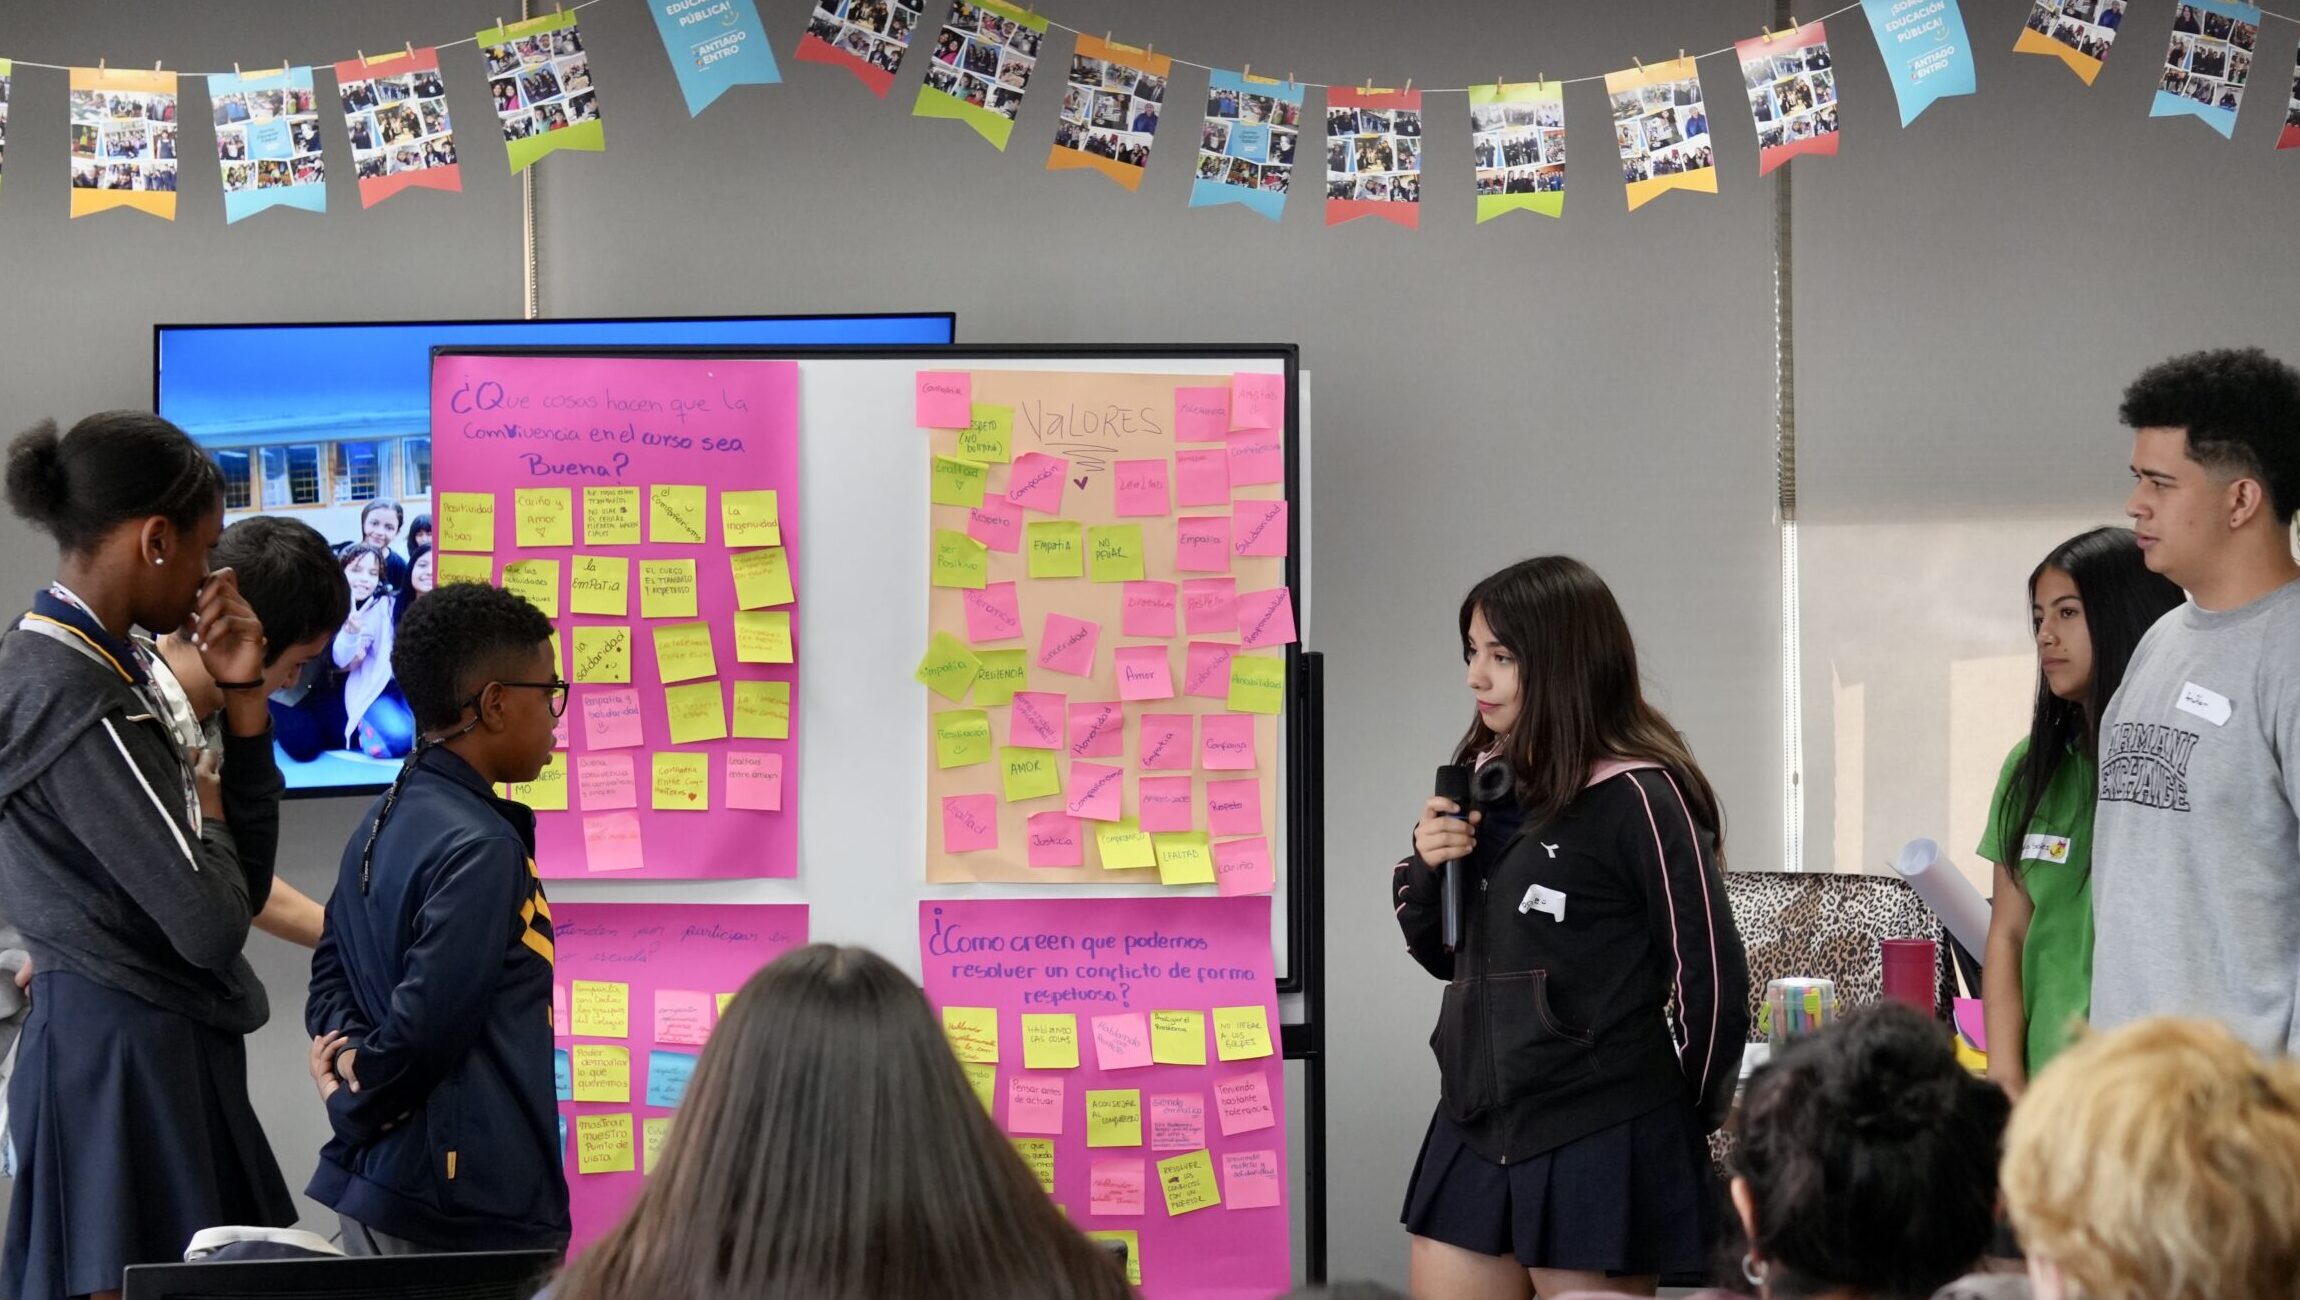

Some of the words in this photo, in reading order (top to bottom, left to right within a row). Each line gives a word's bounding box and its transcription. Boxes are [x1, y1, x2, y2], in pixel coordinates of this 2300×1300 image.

[679, 1, 732, 27] PÚBLICA!
[1885, 2, 1946, 32] EDUCACIÓN
[542, 391, 599, 409] cosas
[606, 390, 664, 410] hacen
[641, 431, 693, 450] curso
[702, 433, 746, 452] sea
[520, 451, 631, 485] Buena?
[1125, 665, 1155, 682] Amor
[1010, 758, 1043, 775] AMOR
[1009, 931, 1076, 952] creen
[1081, 934, 1117, 960] que
[1124, 931, 1208, 955] podemos
[951, 964, 1036, 979] resolver
[1044, 966, 1069, 979] un
[1075, 964, 1162, 982] conflicto
[1168, 962, 1191, 979] de
[1195, 966, 1257, 983] forma
